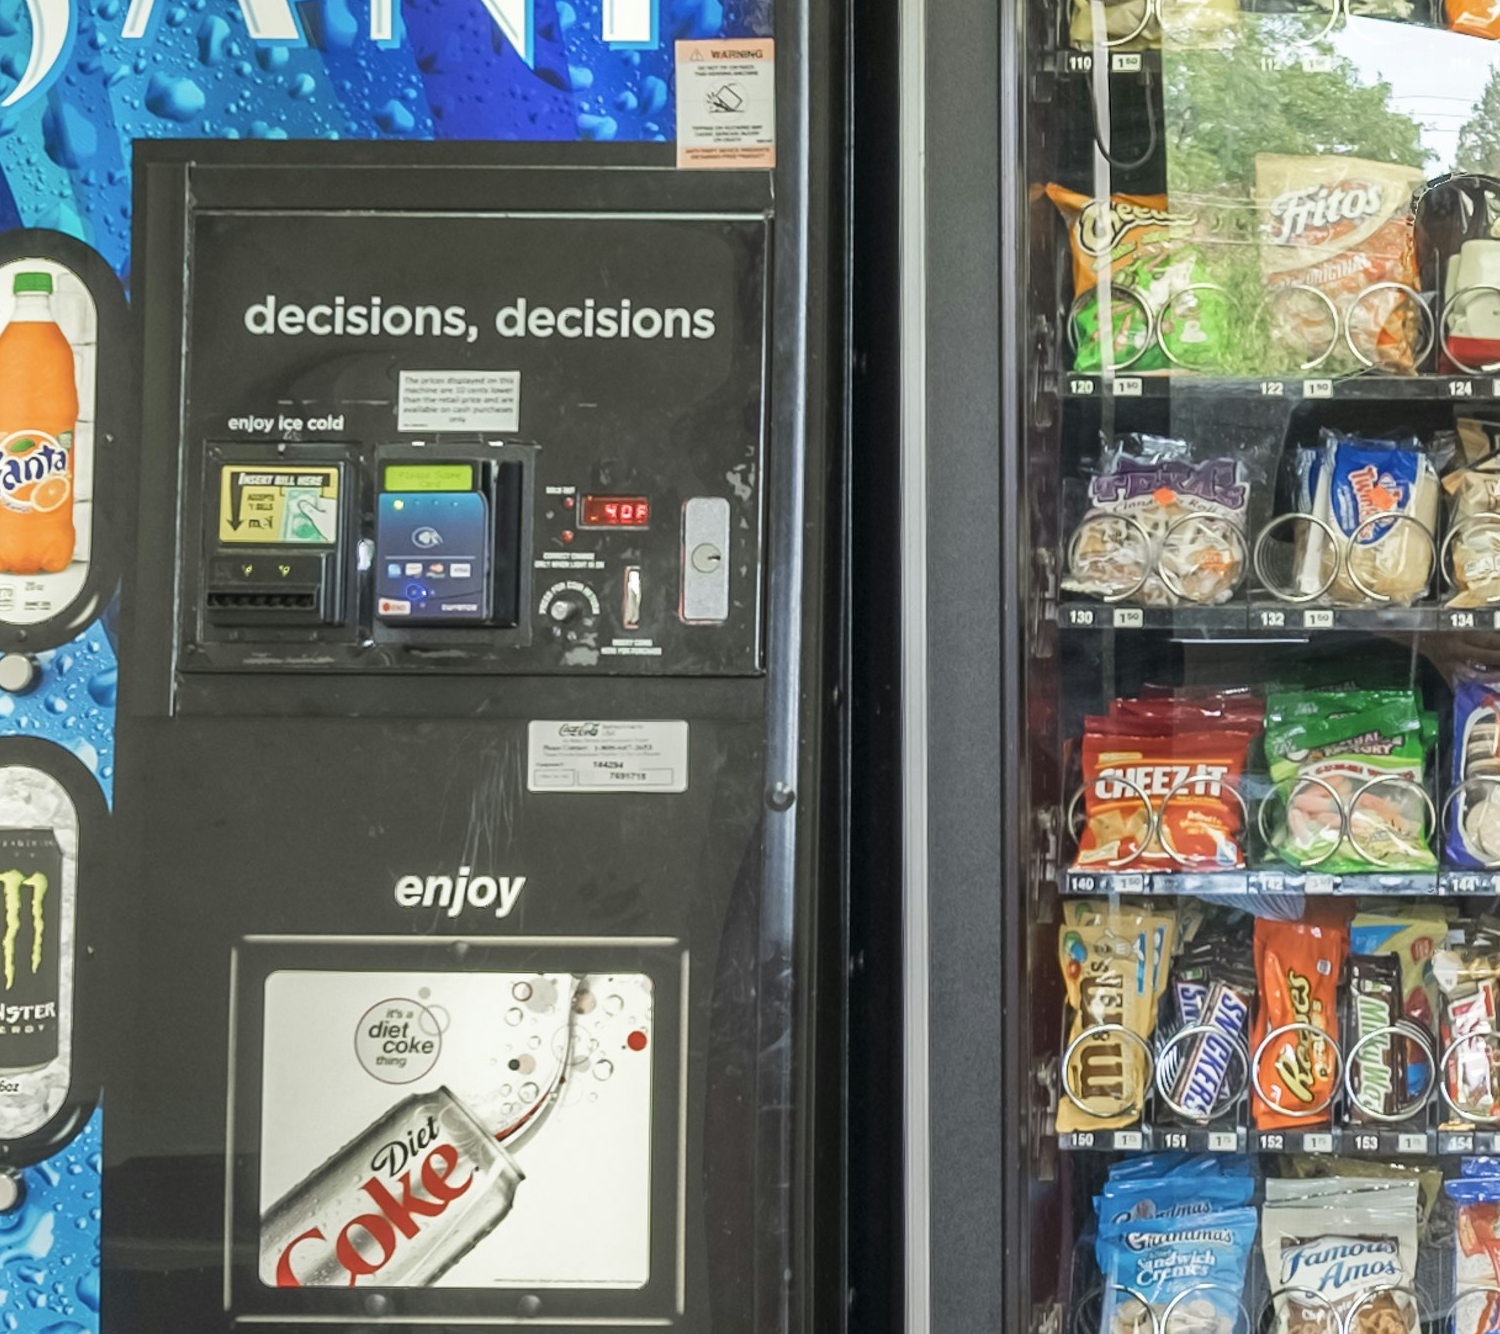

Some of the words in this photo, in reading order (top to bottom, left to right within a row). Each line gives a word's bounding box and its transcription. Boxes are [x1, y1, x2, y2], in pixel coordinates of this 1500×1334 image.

[710, 49, 763, 60] WARNING
[1069, 56, 1092, 69] 110
[1271, 177, 1384, 244] Fritos
[244, 295, 479, 343] decisions,
[495, 298, 716, 339] decisions
[1070, 380, 1094, 395] 120
[1261, 382, 1284, 395] 122
[1449, 381, 1473, 396] 124
[228, 415, 274, 433] enjoy
[279, 414, 303, 430] ice
[307, 414, 344, 431] cold
[1069, 610, 1094, 625] 130
[1261, 611, 1285, 626] 132
[1450, 612, 1475, 627] 134
[1071, 877, 1094, 891] 140
[395, 866, 526, 919] enjoy
[368, 1019, 409, 1039] diet
[1275, 968, 1315, 1103] Reese's
[383, 1036, 434, 1055] coke
[1180, 986, 1248, 1115] SNICKERS
[375, 1053, 407, 1069] thing
[370, 1114, 441, 1179] Diet
[1071, 1133, 1094, 1147] 150
[1164, 1133, 1188, 1148] 151
[1261, 1134, 1284, 1149] 152
[1355, 1134, 1378, 1150] 153
[1450, 1135, 1473, 1150] 154
[274, 1143, 476, 1288] Coke
[1136, 1249, 1216, 1273] Sandwich
[1280, 1239, 1398, 1283] Famous
[1318, 1260, 1398, 1293] Amos
